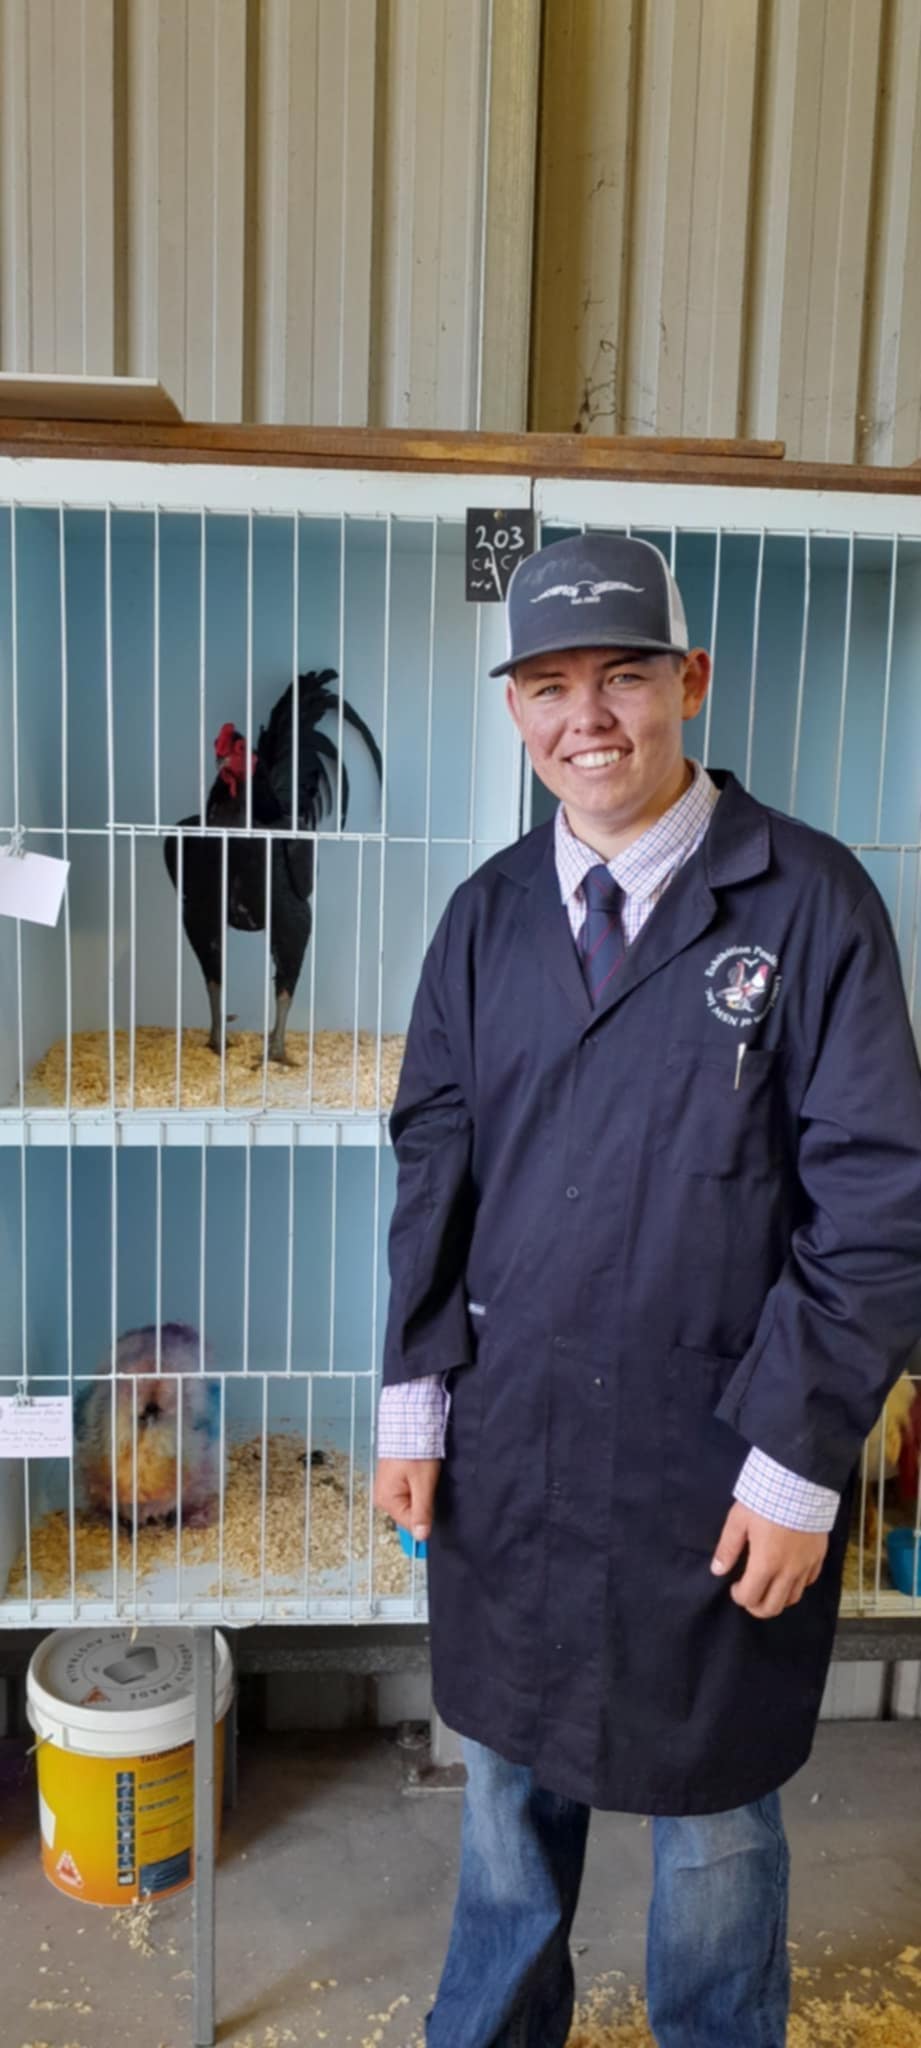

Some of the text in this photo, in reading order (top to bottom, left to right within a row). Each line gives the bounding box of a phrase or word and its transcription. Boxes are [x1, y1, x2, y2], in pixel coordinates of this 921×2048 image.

[475, 525, 525, 551] 203
[704, 945, 751, 977] Exhibition
[711, 1006, 738, 1026] NSW
[130, 1682, 172, 1700] MADE
